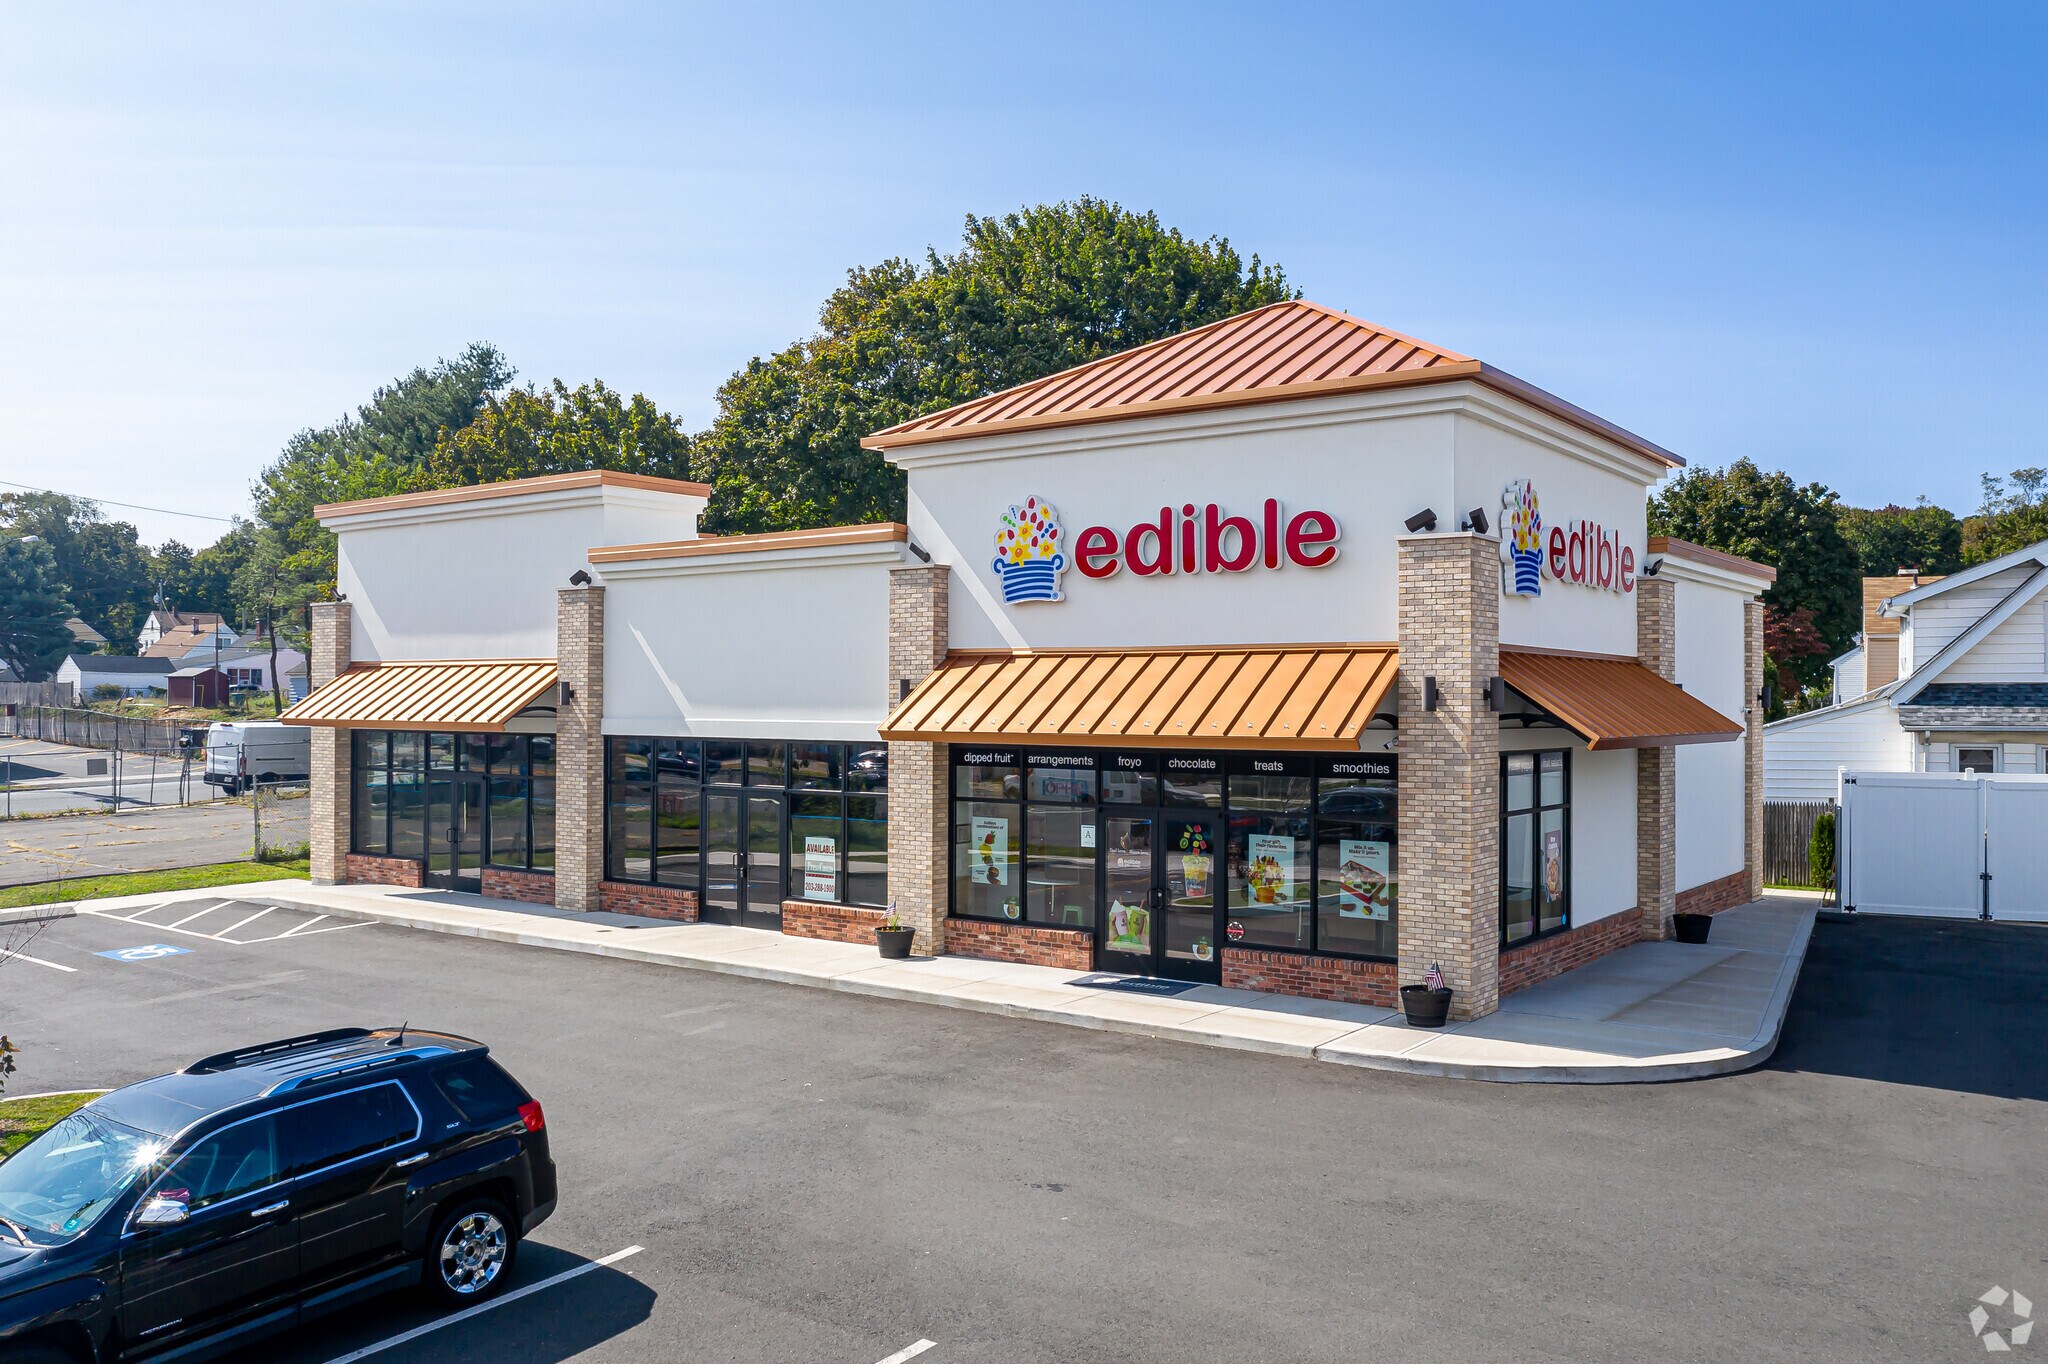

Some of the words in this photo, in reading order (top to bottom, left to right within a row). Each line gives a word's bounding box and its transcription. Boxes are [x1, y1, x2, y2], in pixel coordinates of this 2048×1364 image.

[1074, 497, 1341, 580] edible
[1548, 519, 1636, 594] edible
[964, 752, 993, 764] dipped
[1027, 755, 1094, 767] arrangements
[1118, 756, 1142, 769] froyo
[1168, 757, 1216, 769] chocolate
[1254, 760, 1284, 771] treats
[1332, 762, 1390, 774] smoothies
[1085, 830, 1092, 839] A
[807, 844, 834, 854] AVAILABLE
